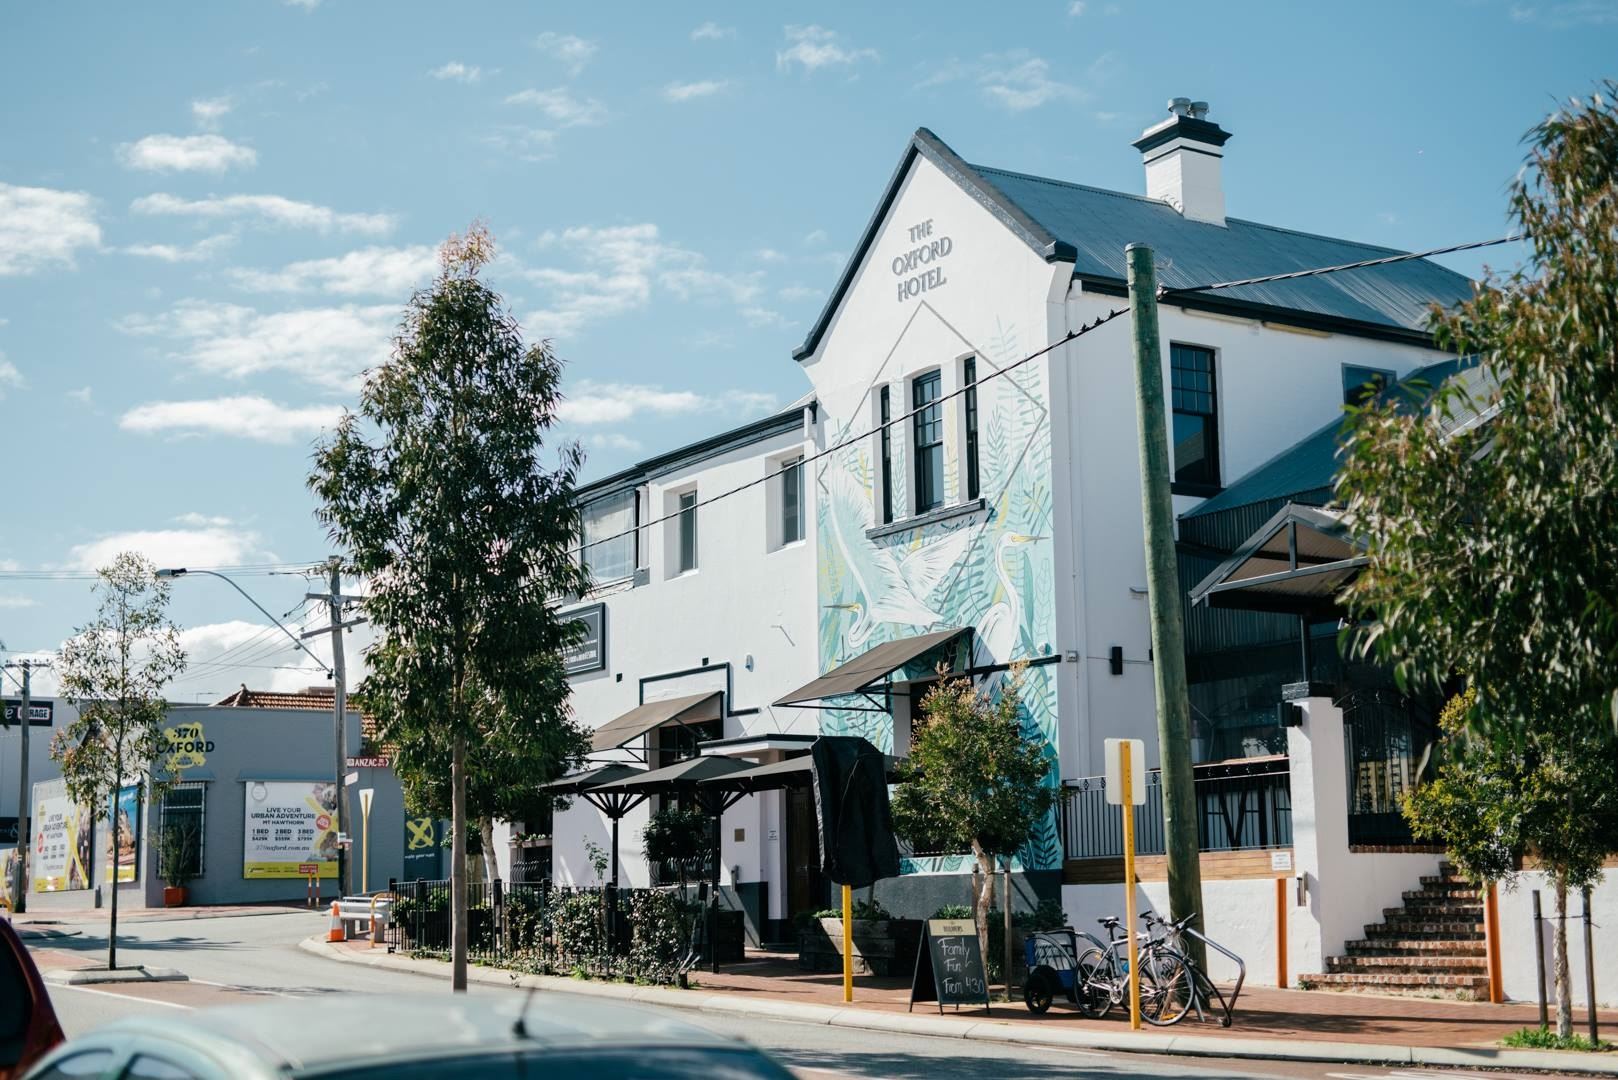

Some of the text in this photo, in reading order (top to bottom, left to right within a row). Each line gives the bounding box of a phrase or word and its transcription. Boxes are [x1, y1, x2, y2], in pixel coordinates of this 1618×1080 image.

[908, 219, 933, 242] THE
[892, 237, 953, 276] OXFORD
[898, 267, 947, 302] HOTEL
[173, 728, 199, 739] 370
[156, 741, 215, 753] OXFORD
[355, 758, 377, 767] ANZAC
[937, 937, 973, 968] Family
[944, 958, 961, 972] Fun
[965, 976, 985, 994] 430
